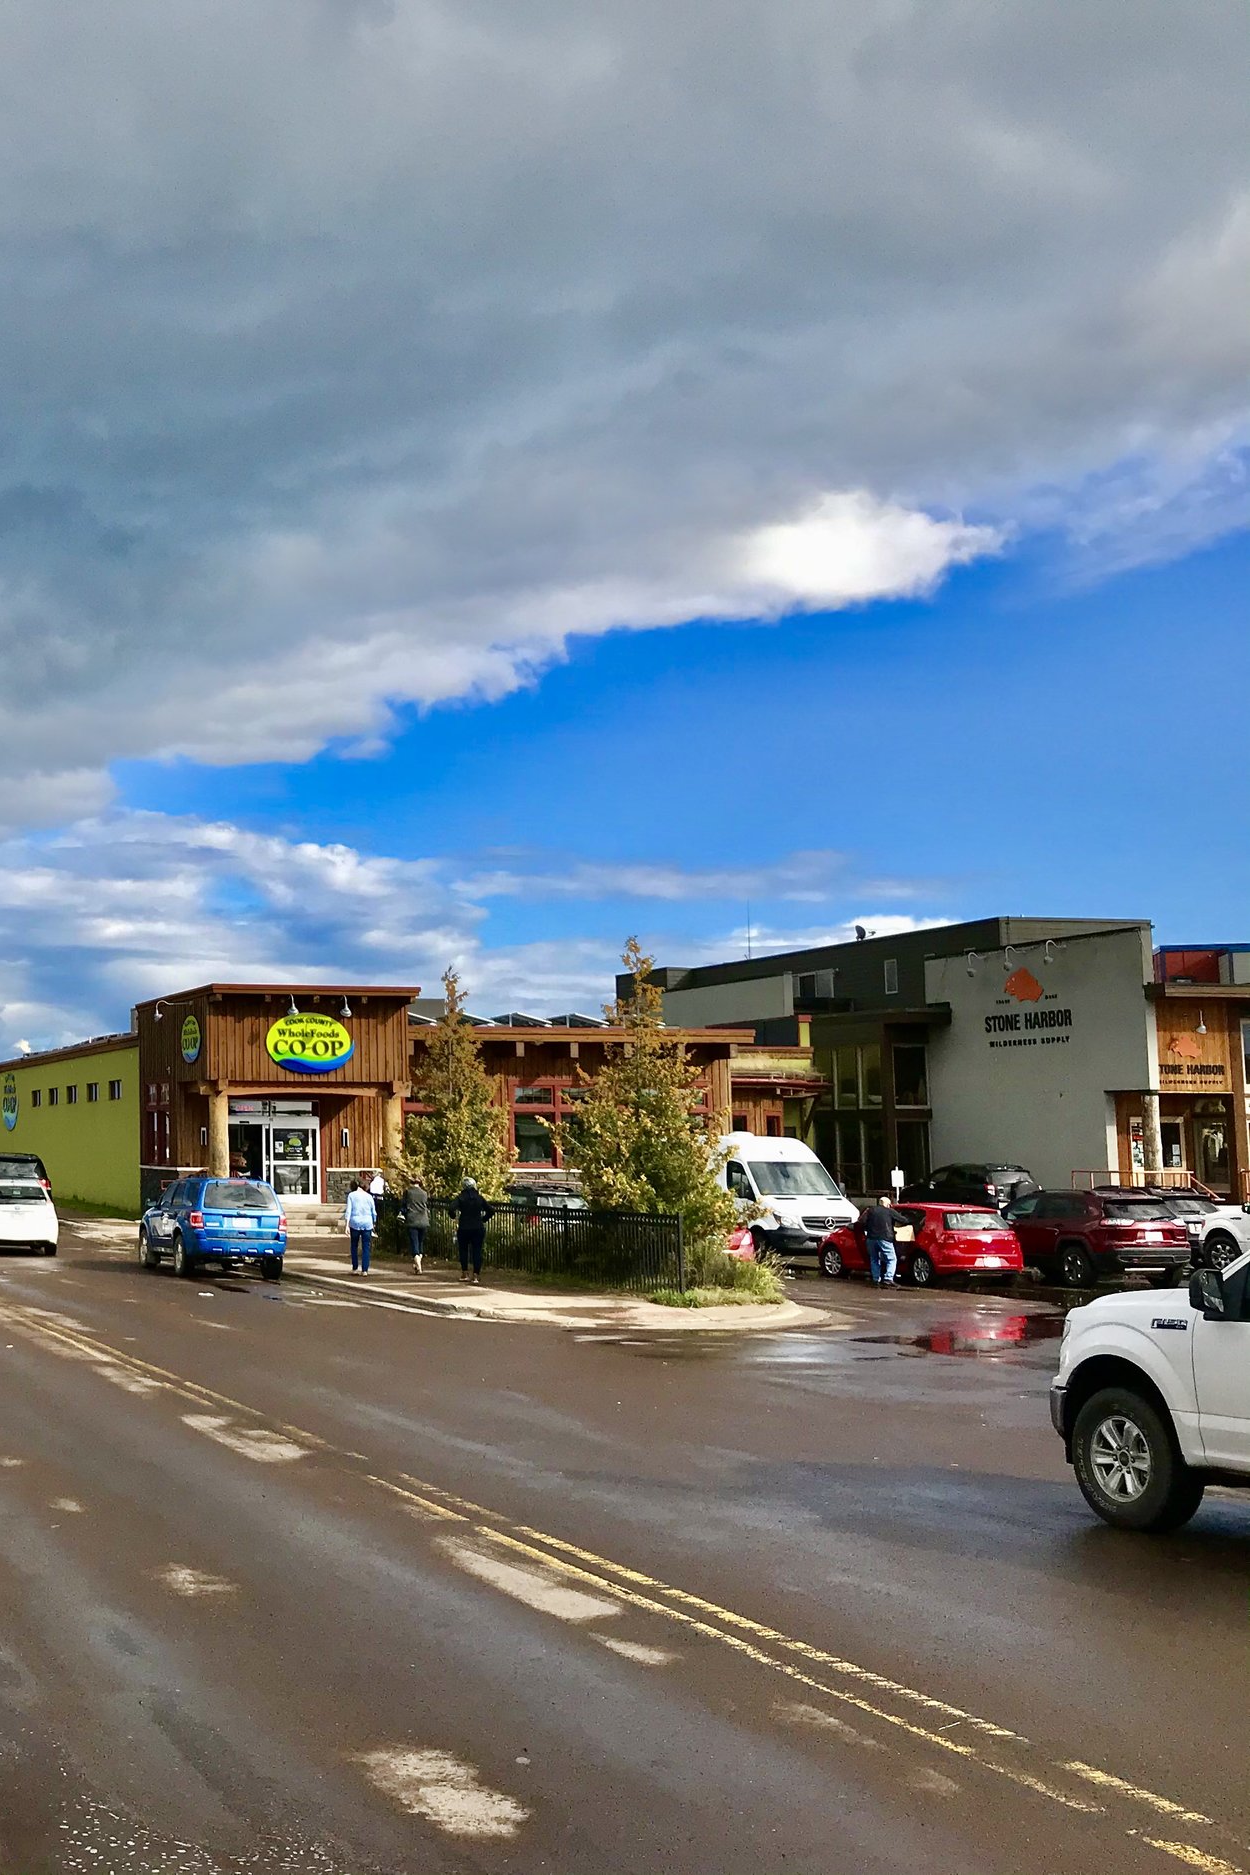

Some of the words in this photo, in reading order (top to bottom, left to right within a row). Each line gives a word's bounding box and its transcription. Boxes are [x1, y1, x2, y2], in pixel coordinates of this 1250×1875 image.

[285, 1018, 305, 1026] COOK
[306, 1017, 334, 1027] COUNTY
[984, 1013, 1021, 1033] STONE
[1024, 1008, 1073, 1030] HARBOR
[277, 1028, 340, 1038] WholeFoods
[273, 1039, 344, 1056] CO-OP
[989, 1038, 1037, 1048] WILDERNESS
[1040, 1035, 1070, 1045] SUPPLY
[1159, 1064, 1183, 1075] TONE
